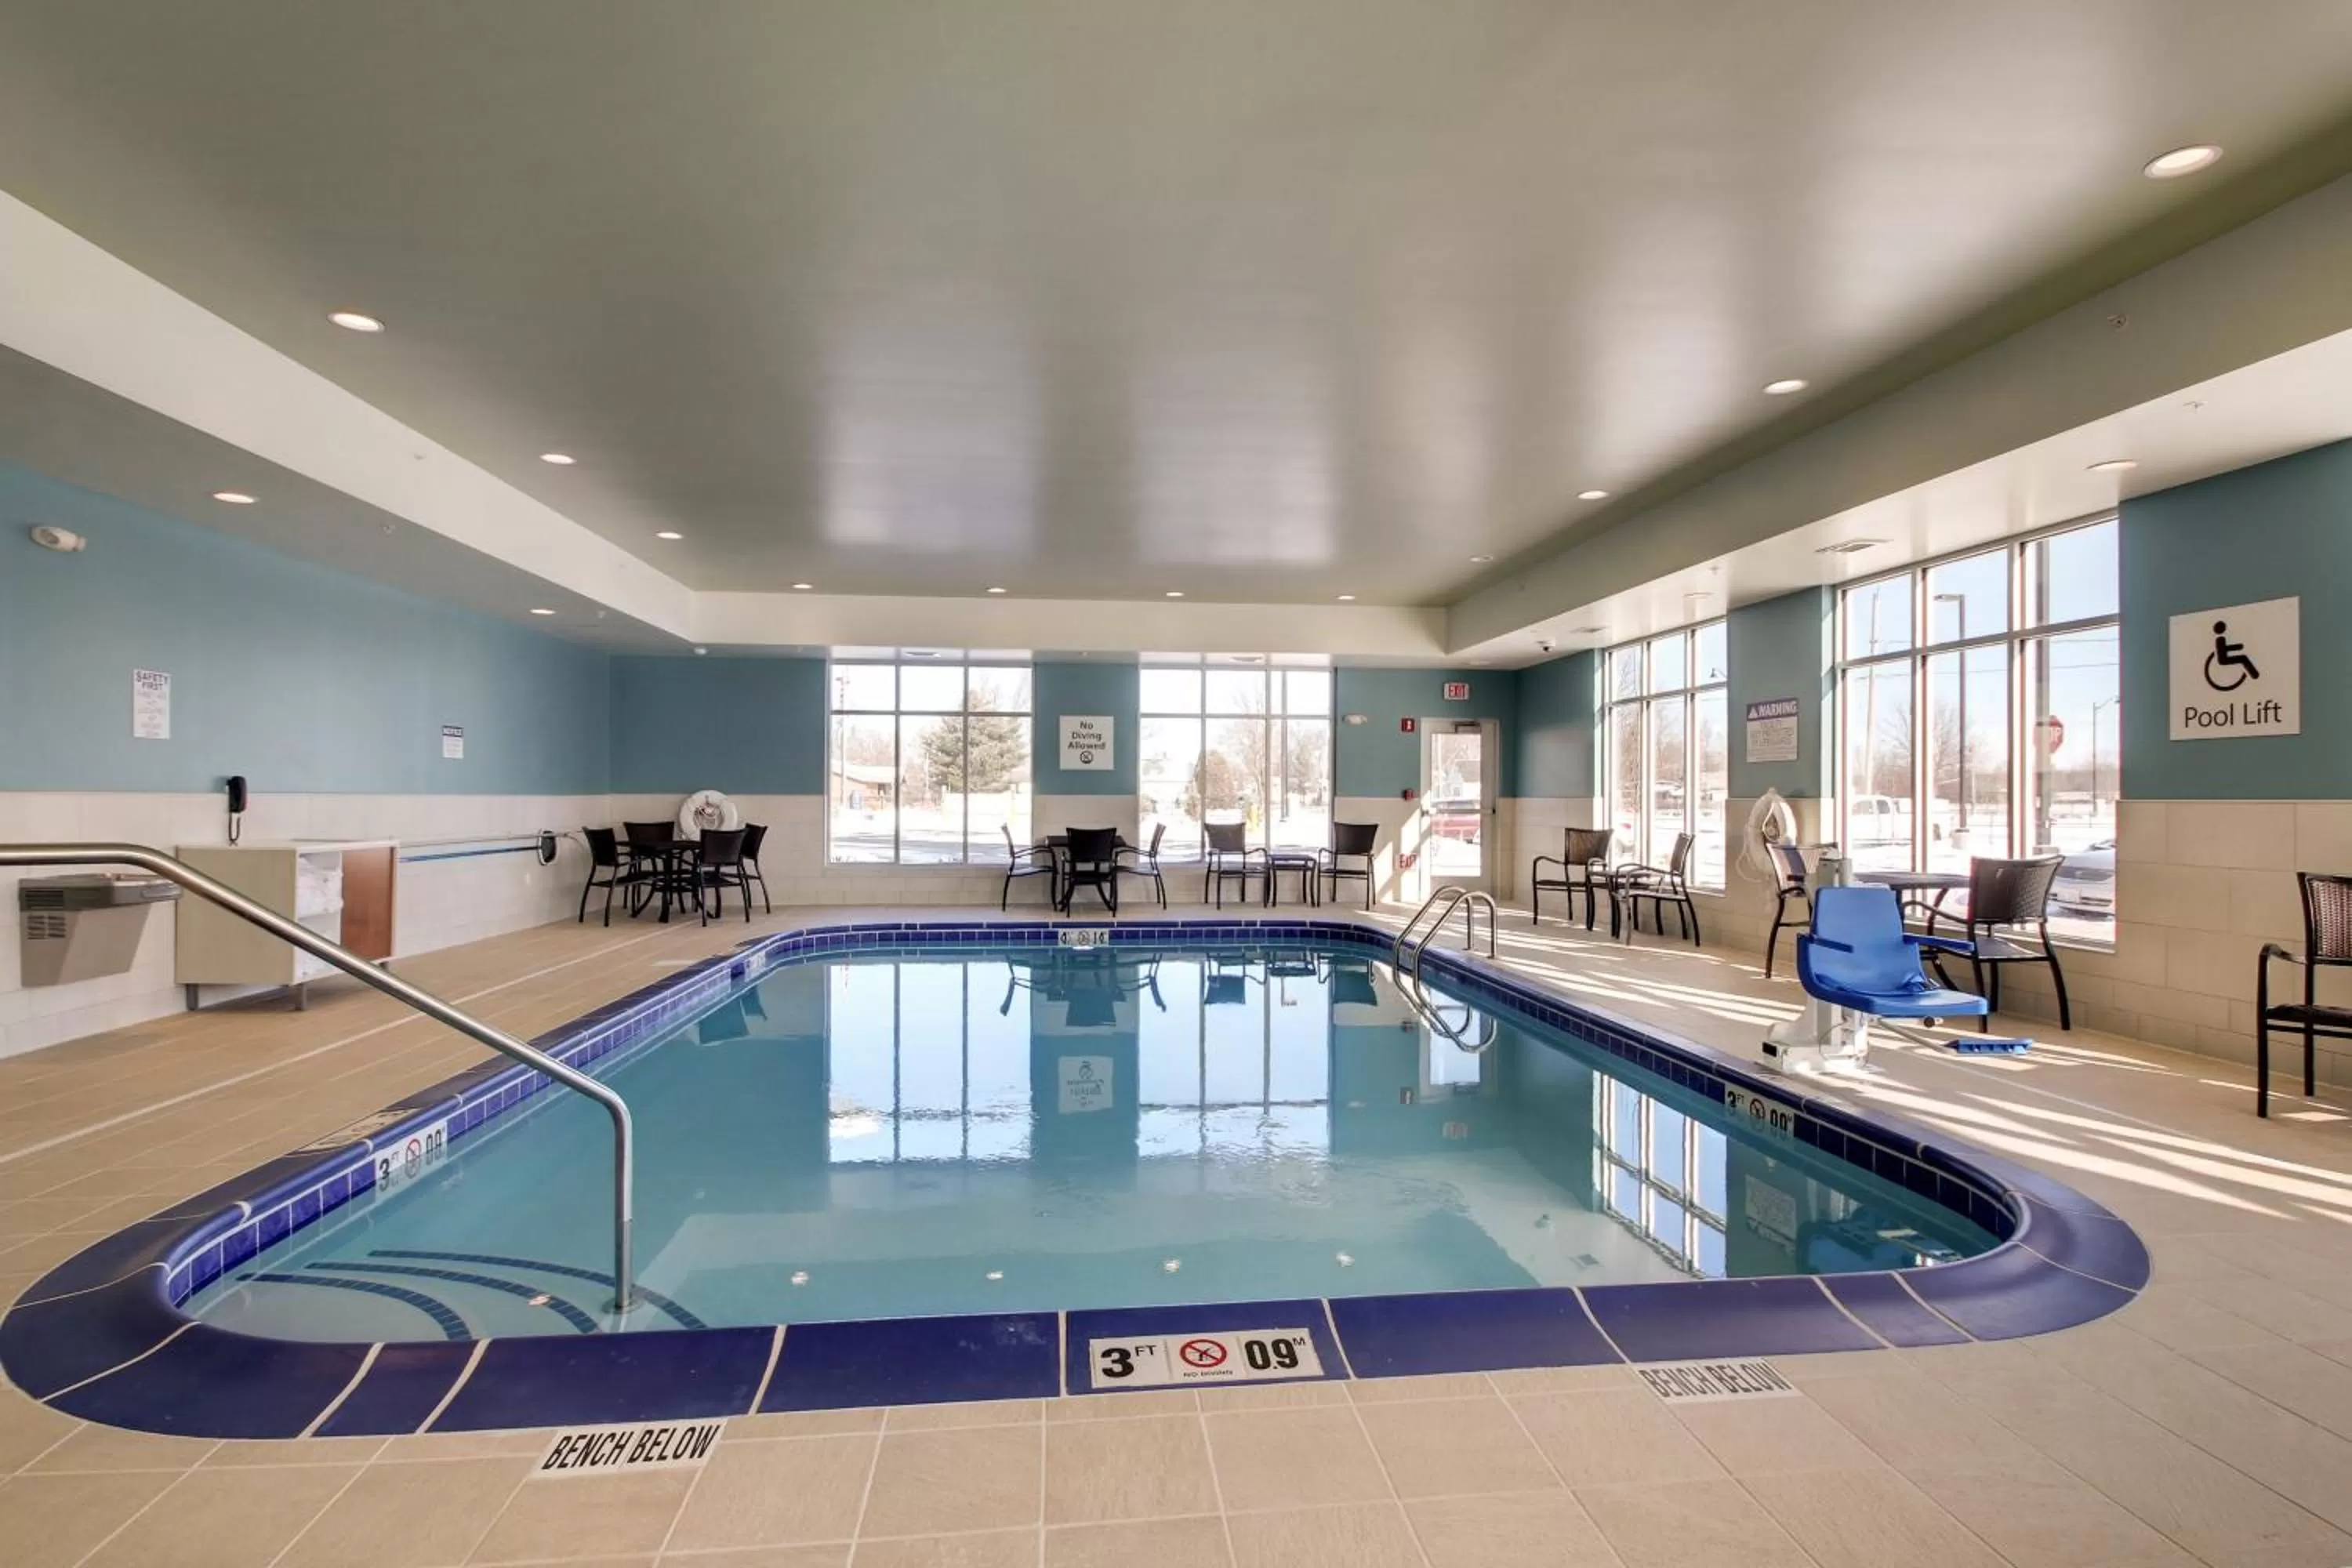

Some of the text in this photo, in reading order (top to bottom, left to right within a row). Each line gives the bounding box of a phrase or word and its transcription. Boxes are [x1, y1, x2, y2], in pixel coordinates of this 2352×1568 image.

[1758, 700, 1797, 717] WARNING
[2185, 700, 2282, 728] Pool Lift
[1067, 741, 1106, 750] Allowed
[1072, 732, 1102, 742] Diving
[1101, 1348, 1134, 1378] 3
[1135, 1345, 1156, 1357] FT
[1638, 1361, 1794, 1398] BENCH BELOW
[541, 1424, 721, 1470] BENCH BELOW
